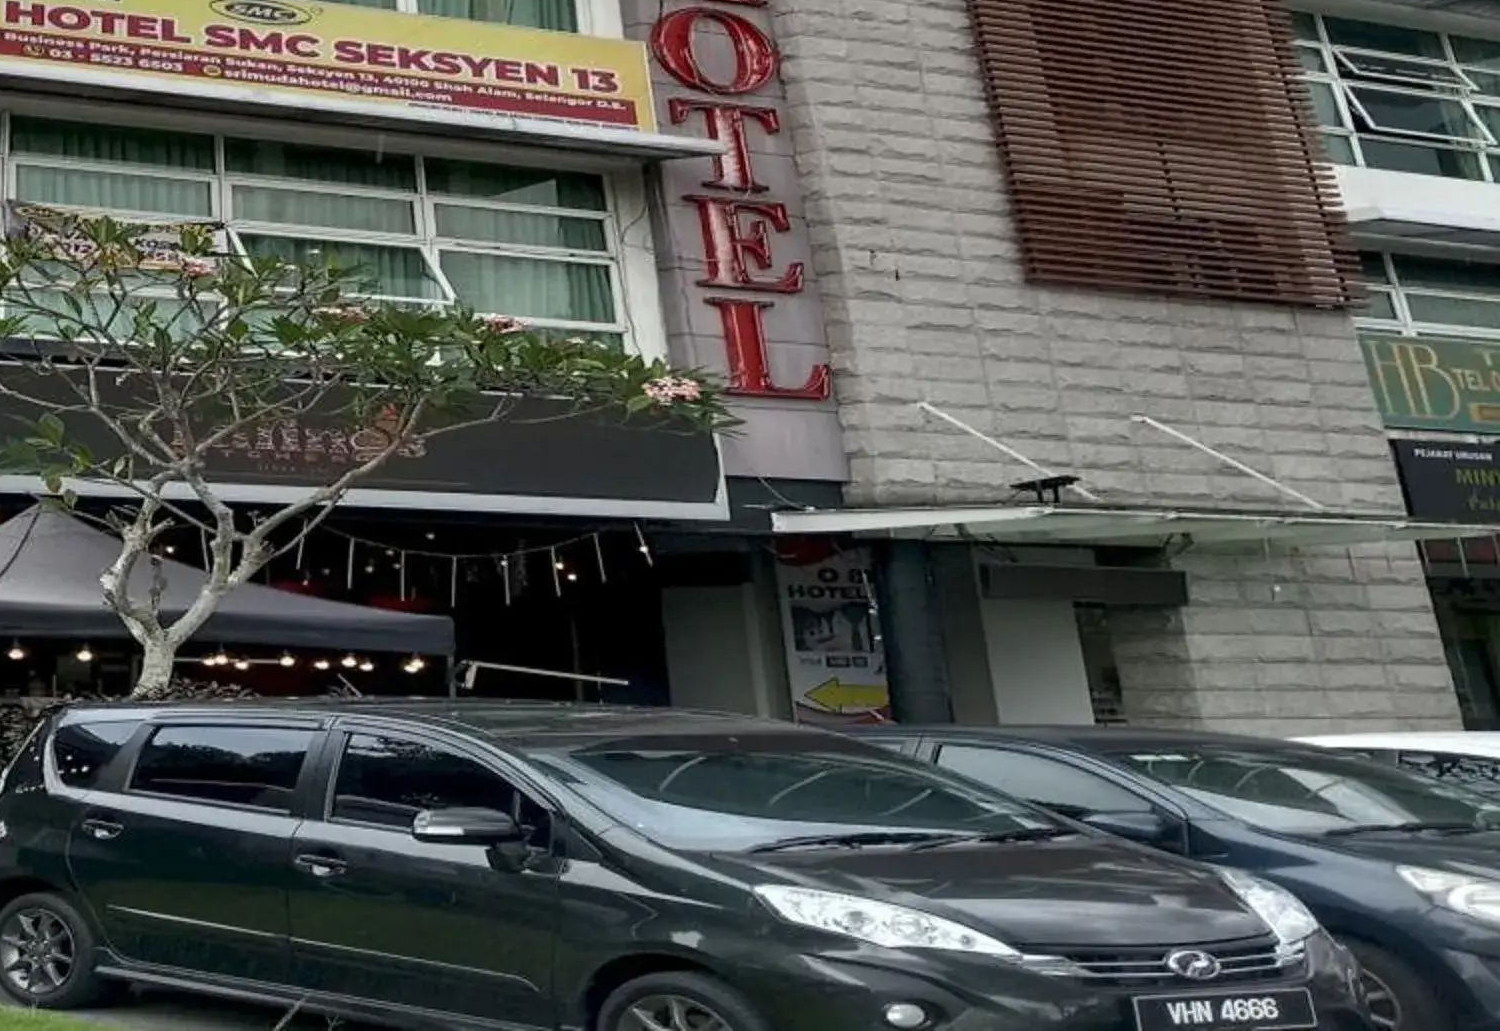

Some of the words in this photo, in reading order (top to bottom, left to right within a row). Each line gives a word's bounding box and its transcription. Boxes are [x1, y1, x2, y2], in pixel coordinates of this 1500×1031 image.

[5, 0, 191, 43] HOTEL
[205, 25, 320, 58] SMC
[334, 40, 560, 87] SEKSYEN
[571, 69, 619, 93] 13
[5, 31, 85, 49] Business
[89, 41, 135, 56] Park,
[138, 47, 221, 66] Persiaran
[225, 56, 282, 73] Sukan,
[286, 62, 354, 80] Seksyen
[434, 80, 474, 93] Shah
[477, 86, 521, 100] Alam,
[526, 92, 592, 108] Selangor
[788, 584, 869, 599] HOTEL
[1166, 1001, 1213, 1025] VHN
[1221, 998, 1280, 1020] 4666
